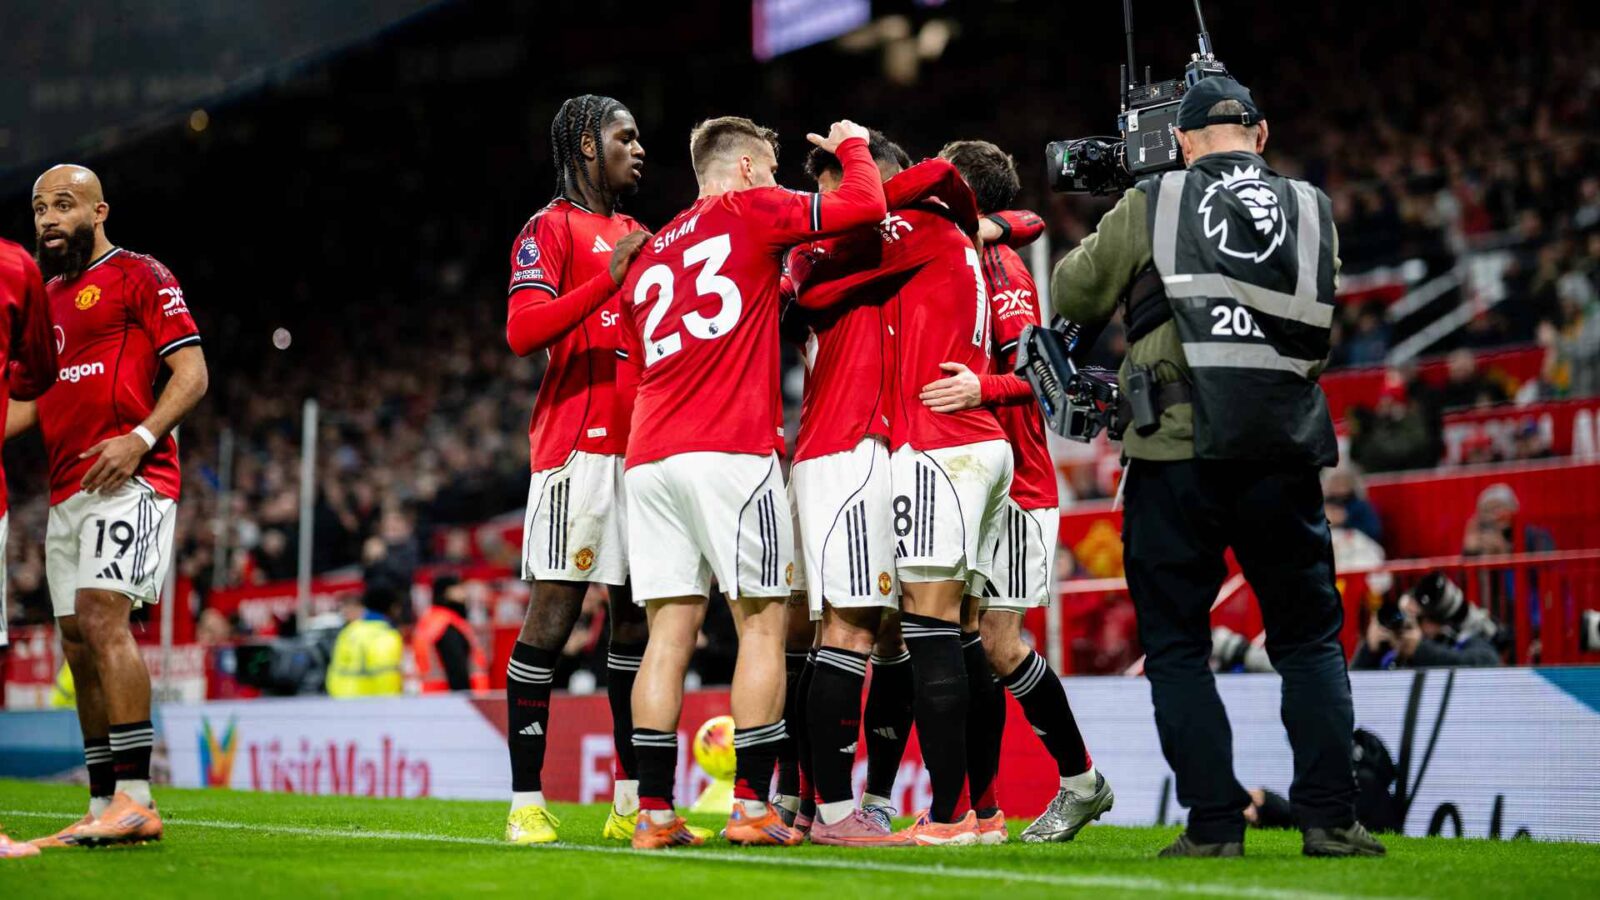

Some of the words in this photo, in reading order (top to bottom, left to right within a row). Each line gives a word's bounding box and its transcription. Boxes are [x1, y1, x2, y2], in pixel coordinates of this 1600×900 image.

[653, 213, 700, 254] SHAW
[880, 212, 913, 240] XC
[633, 232, 743, 368] 23
[964, 246, 992, 360] 1
[992, 288, 1033, 315] DXC
[58, 361, 104, 383] agon
[94, 519, 135, 559] 19
